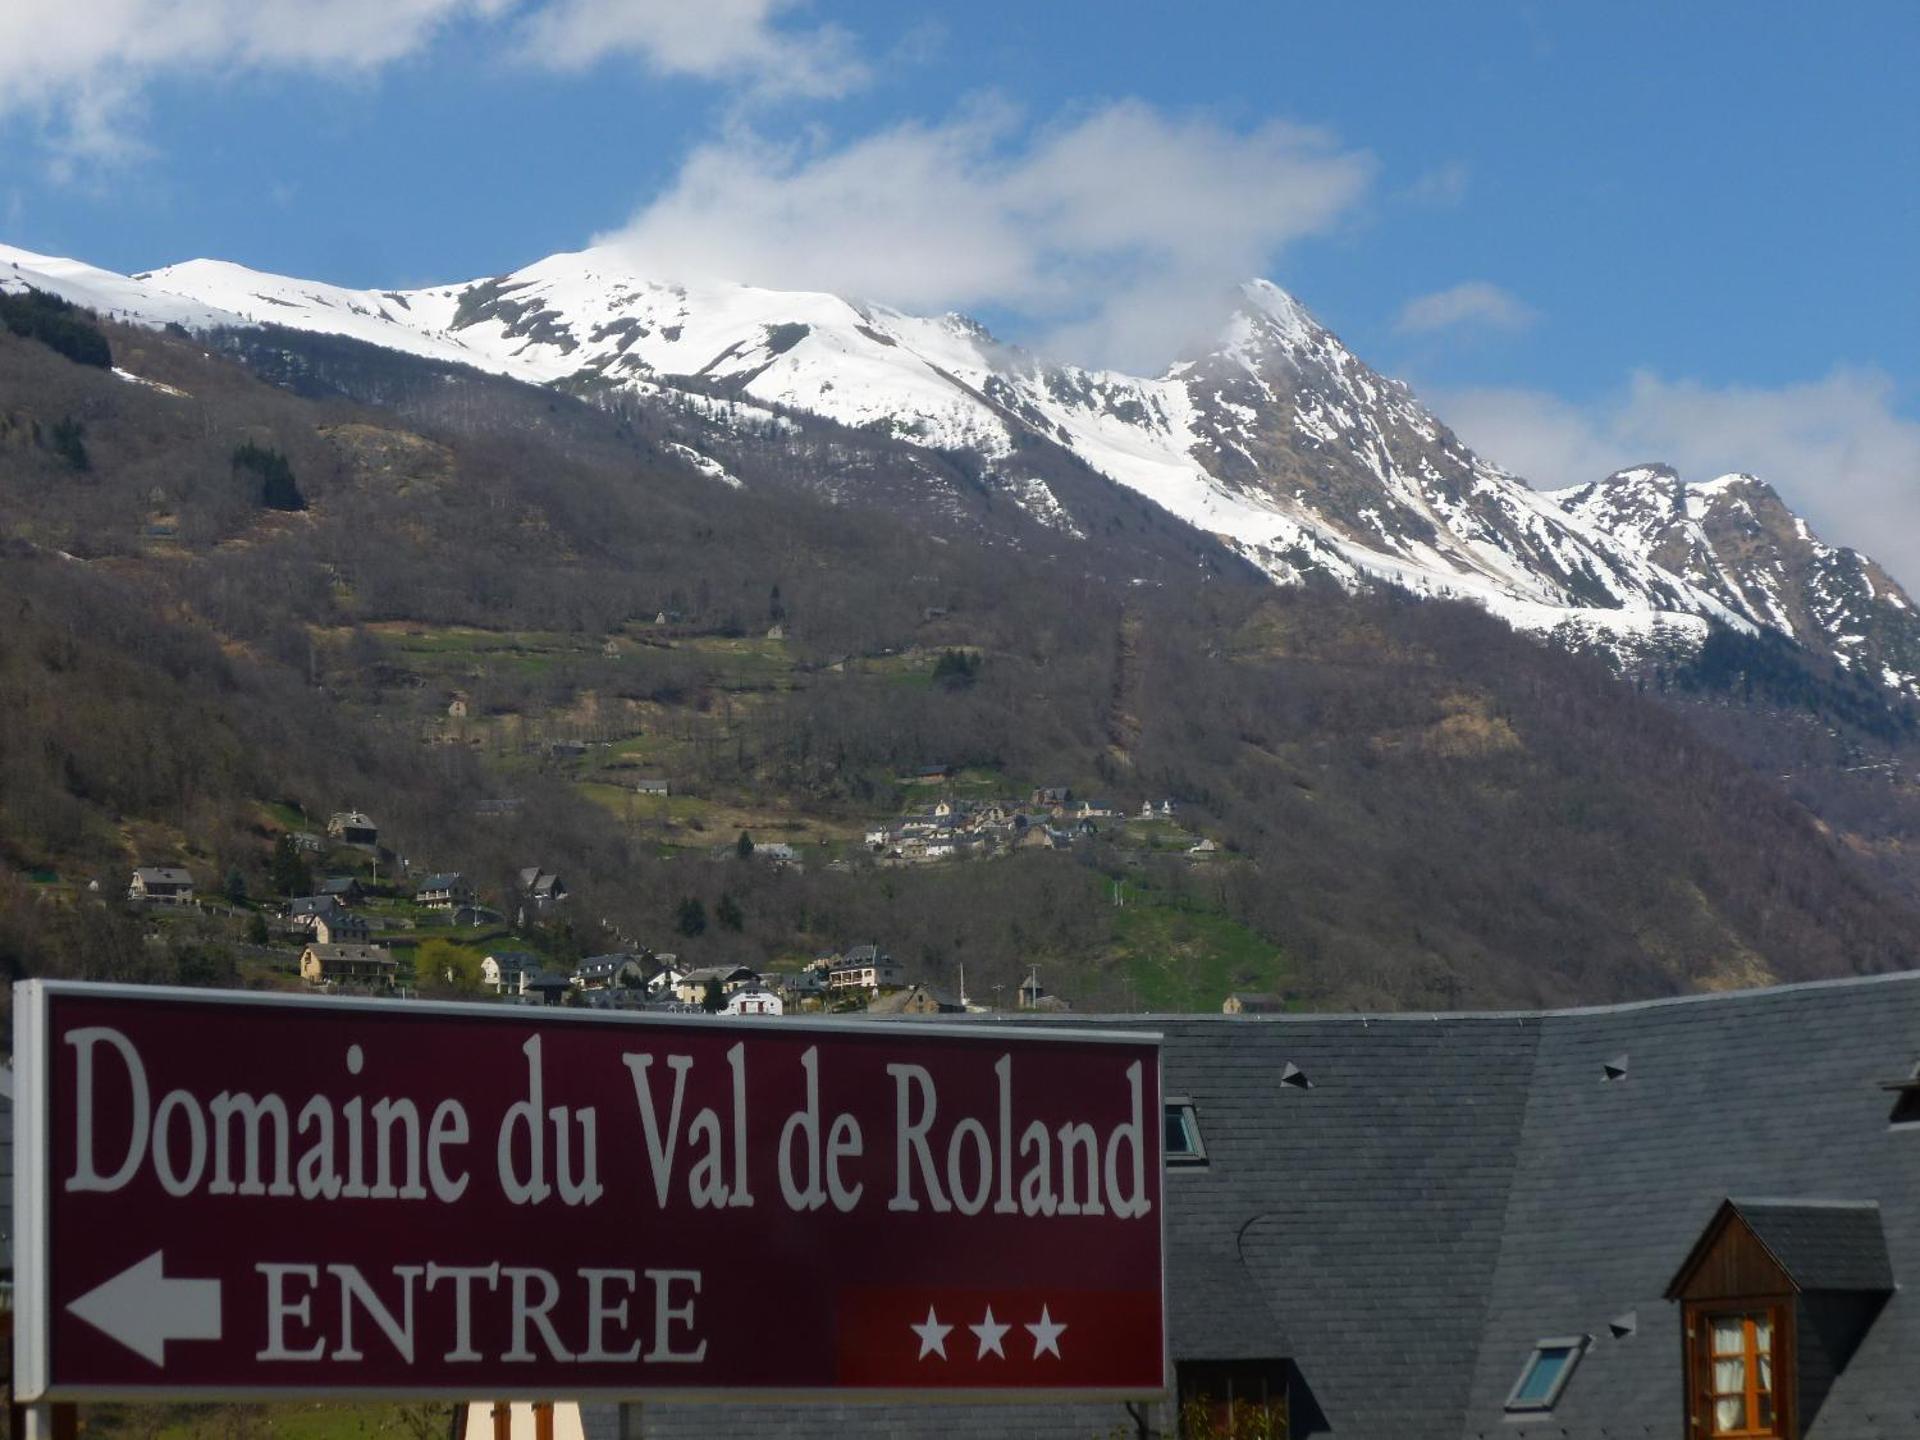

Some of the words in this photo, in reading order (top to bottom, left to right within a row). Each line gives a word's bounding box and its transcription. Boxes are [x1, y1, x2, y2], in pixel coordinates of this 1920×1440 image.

[64, 1026, 470, 1203] Domaine
[497, 1033, 604, 1206] du
[622, 1041, 754, 1210] Val
[778, 1045, 863, 1213] de
[886, 1053, 1151, 1219] Roland
[255, 1262, 708, 1364] ENTREE
